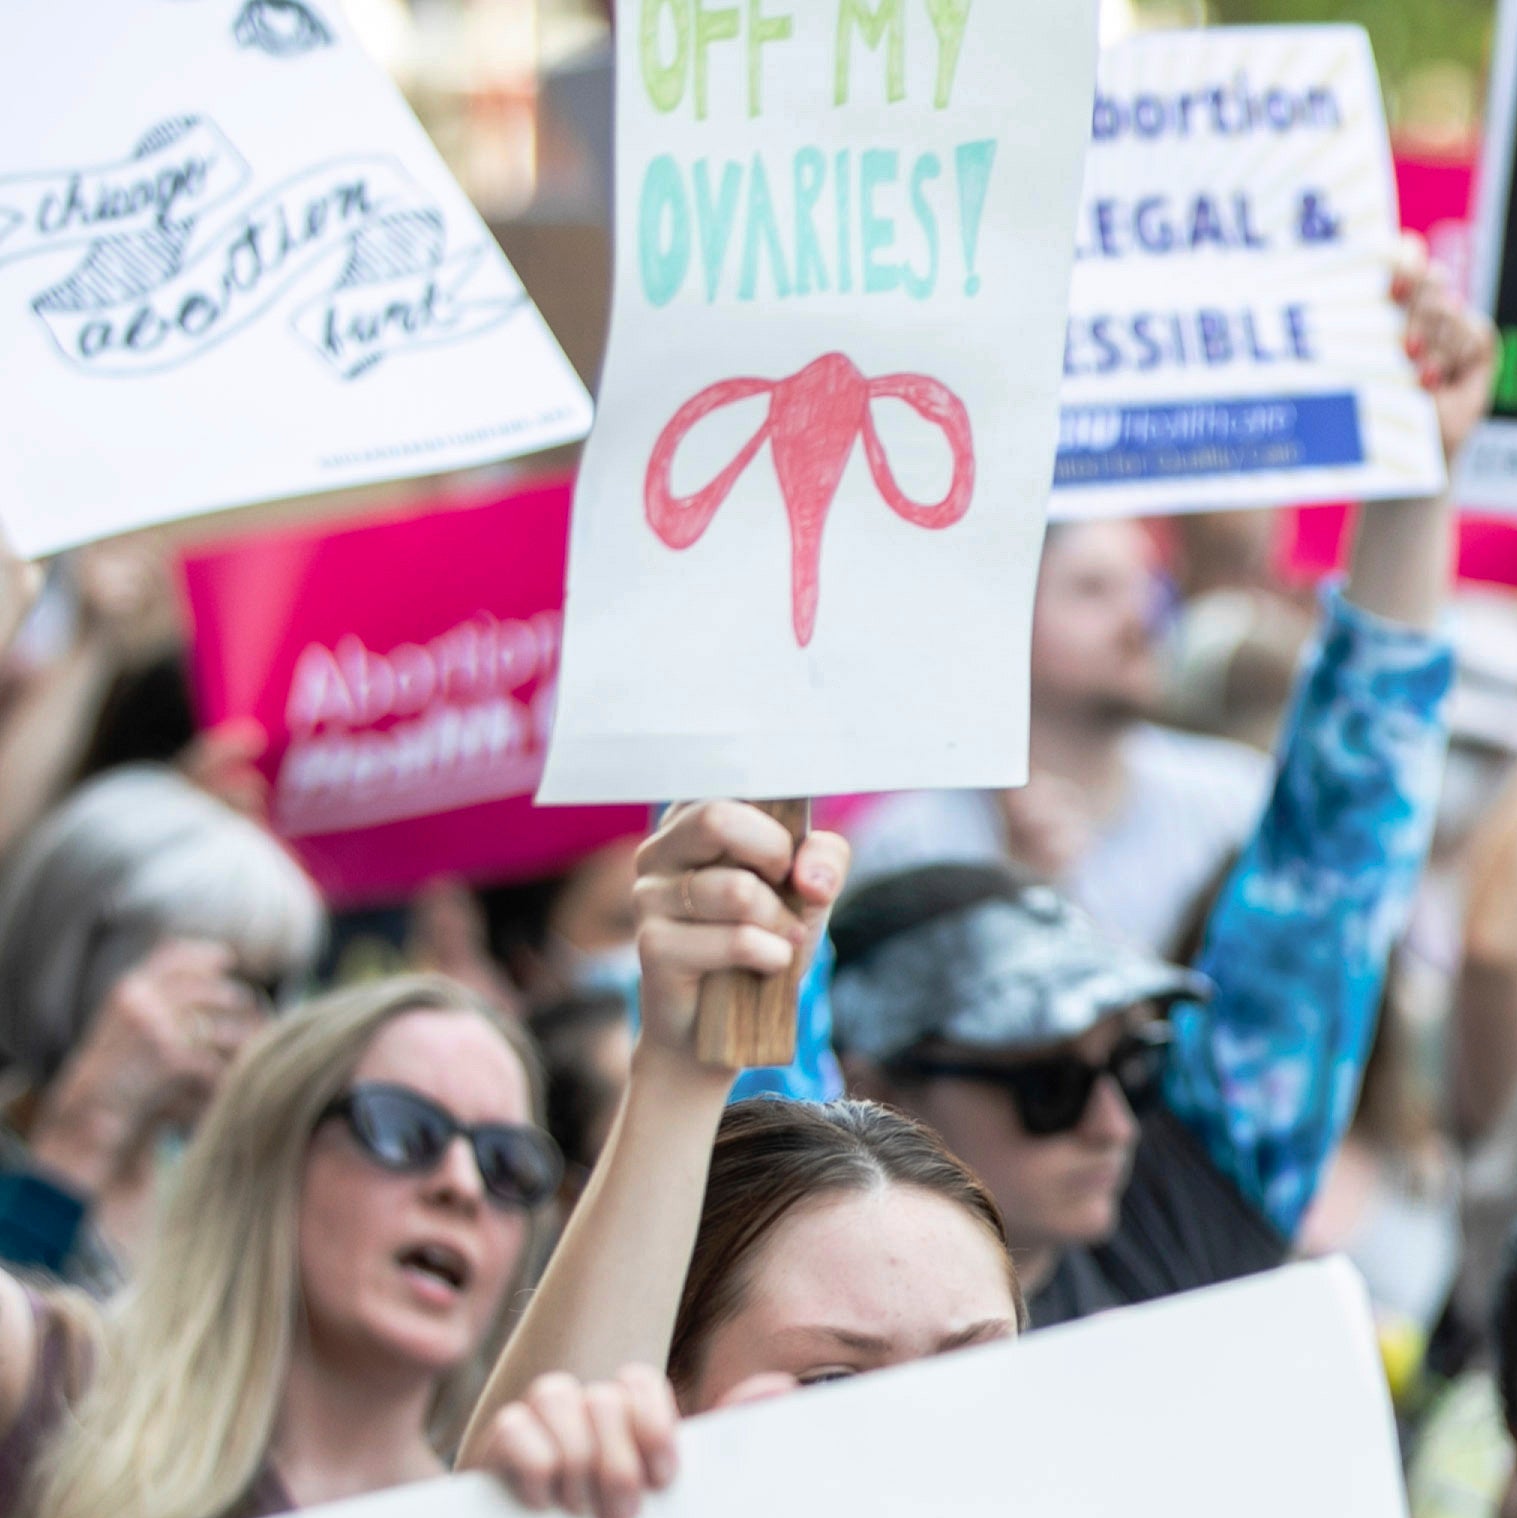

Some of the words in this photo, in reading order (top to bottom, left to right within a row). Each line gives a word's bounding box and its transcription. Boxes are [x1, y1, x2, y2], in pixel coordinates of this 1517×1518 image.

[640, 0, 792, 121] OFF
[833, 0, 972, 110] MY
[637, 138, 998, 310] OVARIES!
[1073, 188, 1270, 260] EGAL
